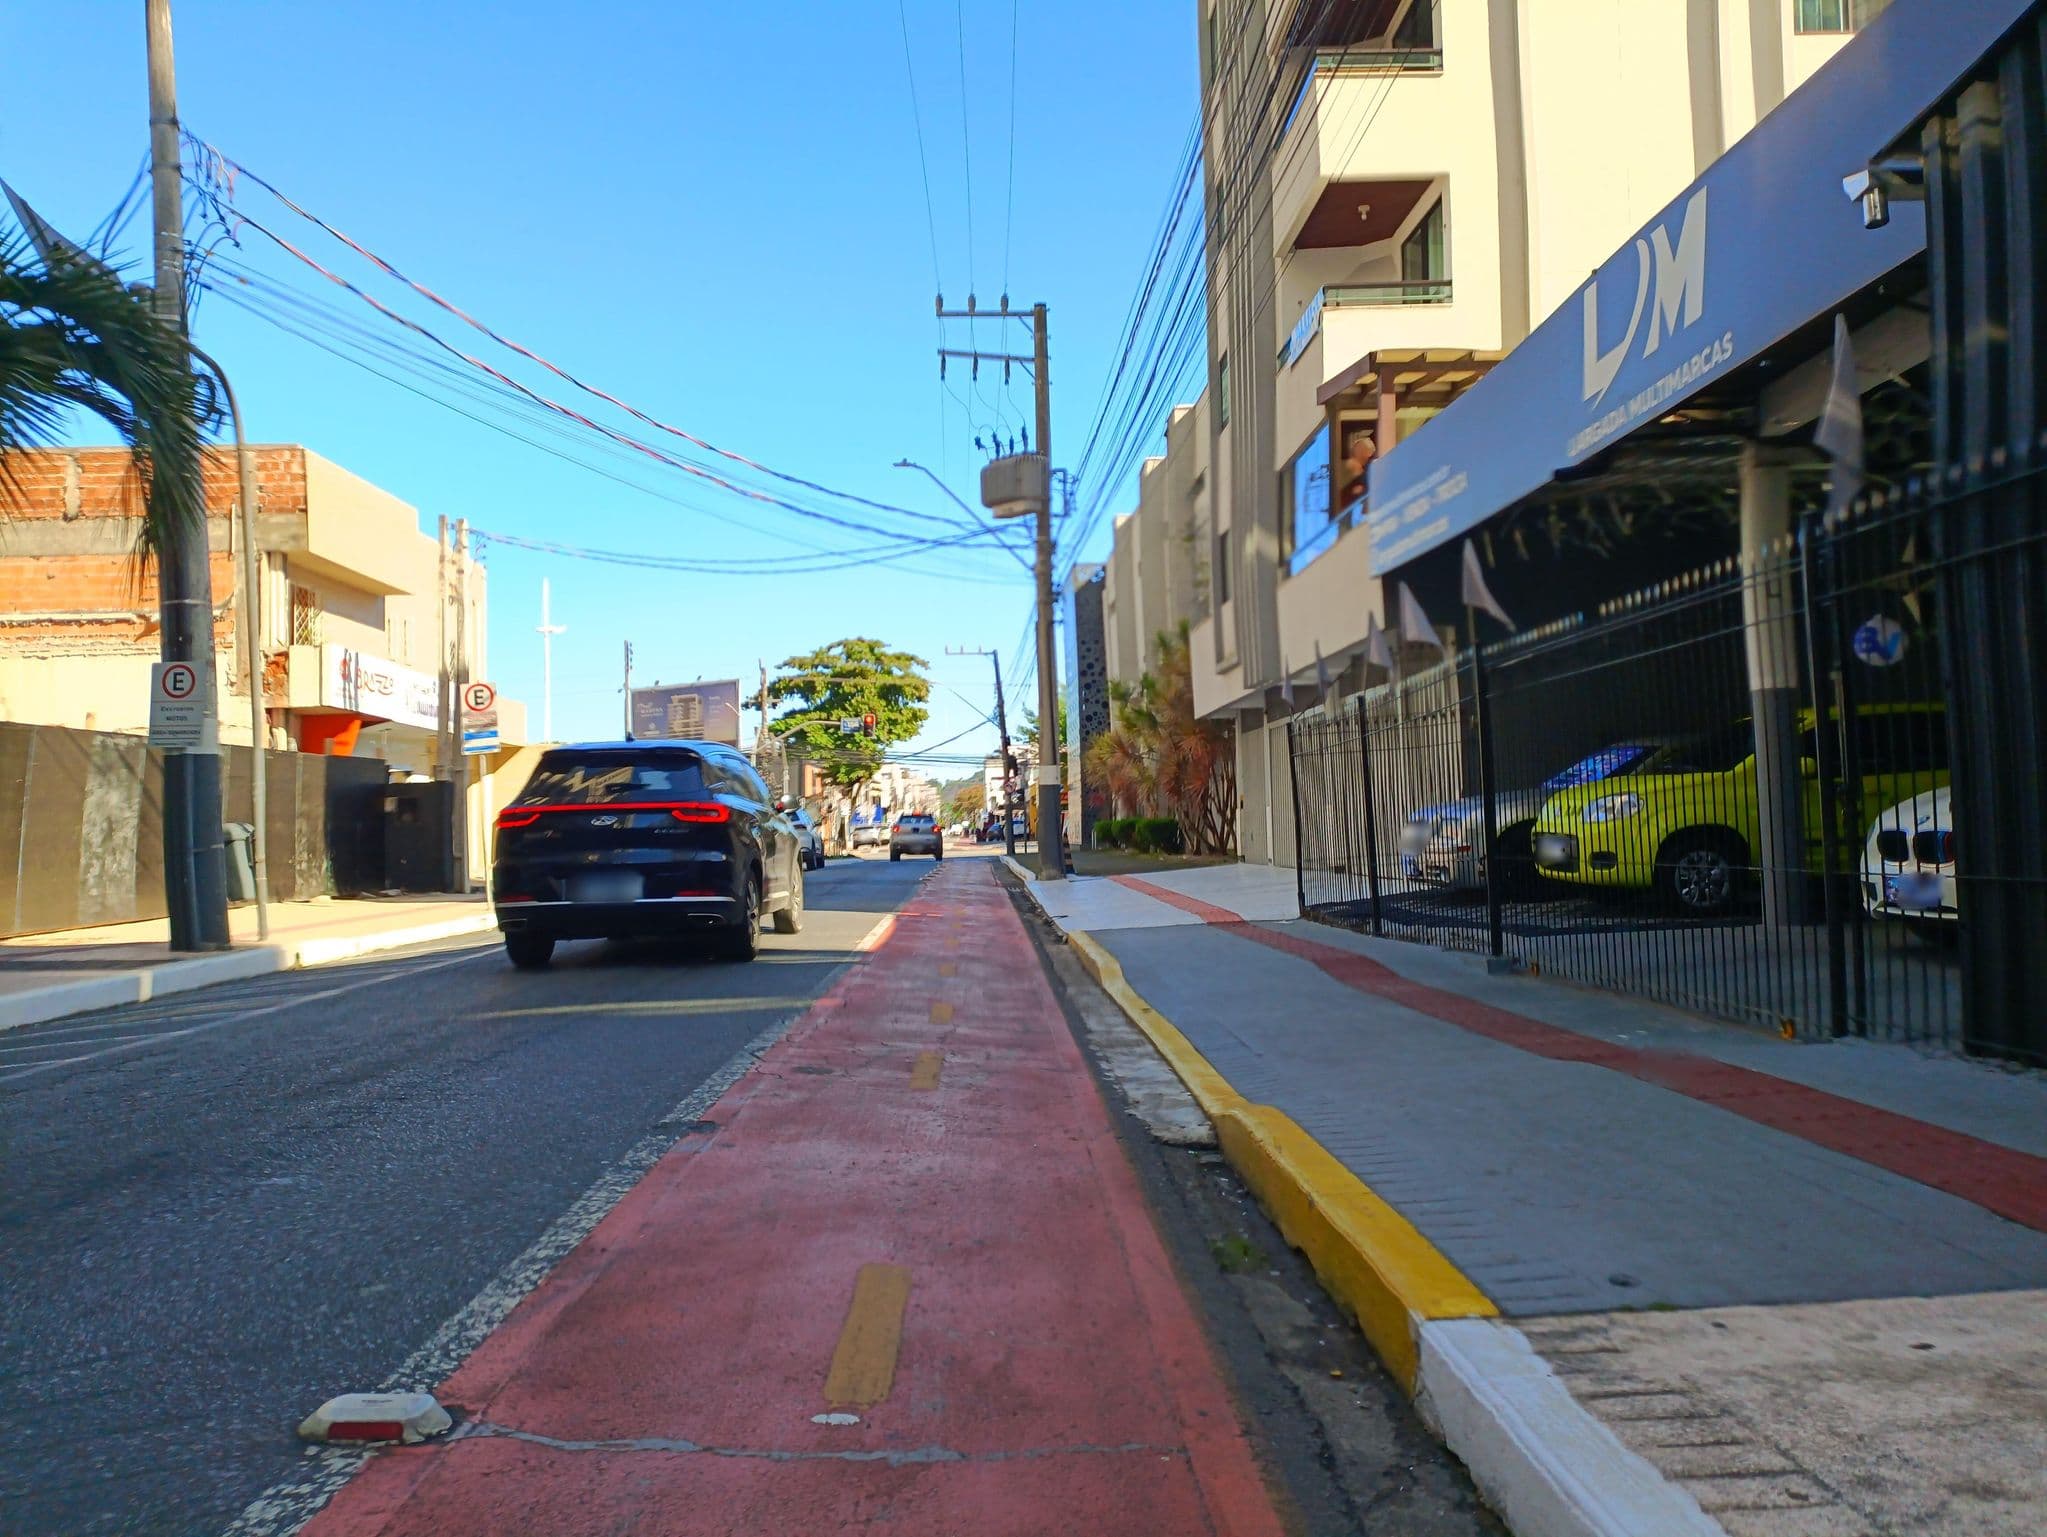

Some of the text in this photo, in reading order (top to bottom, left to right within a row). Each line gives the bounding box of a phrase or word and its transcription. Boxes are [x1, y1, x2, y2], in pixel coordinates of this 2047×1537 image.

[1629, 330, 1734, 420] MULTIMARCAS
[172, 671, 185, 691] E
[473, 688, 485, 706] E
